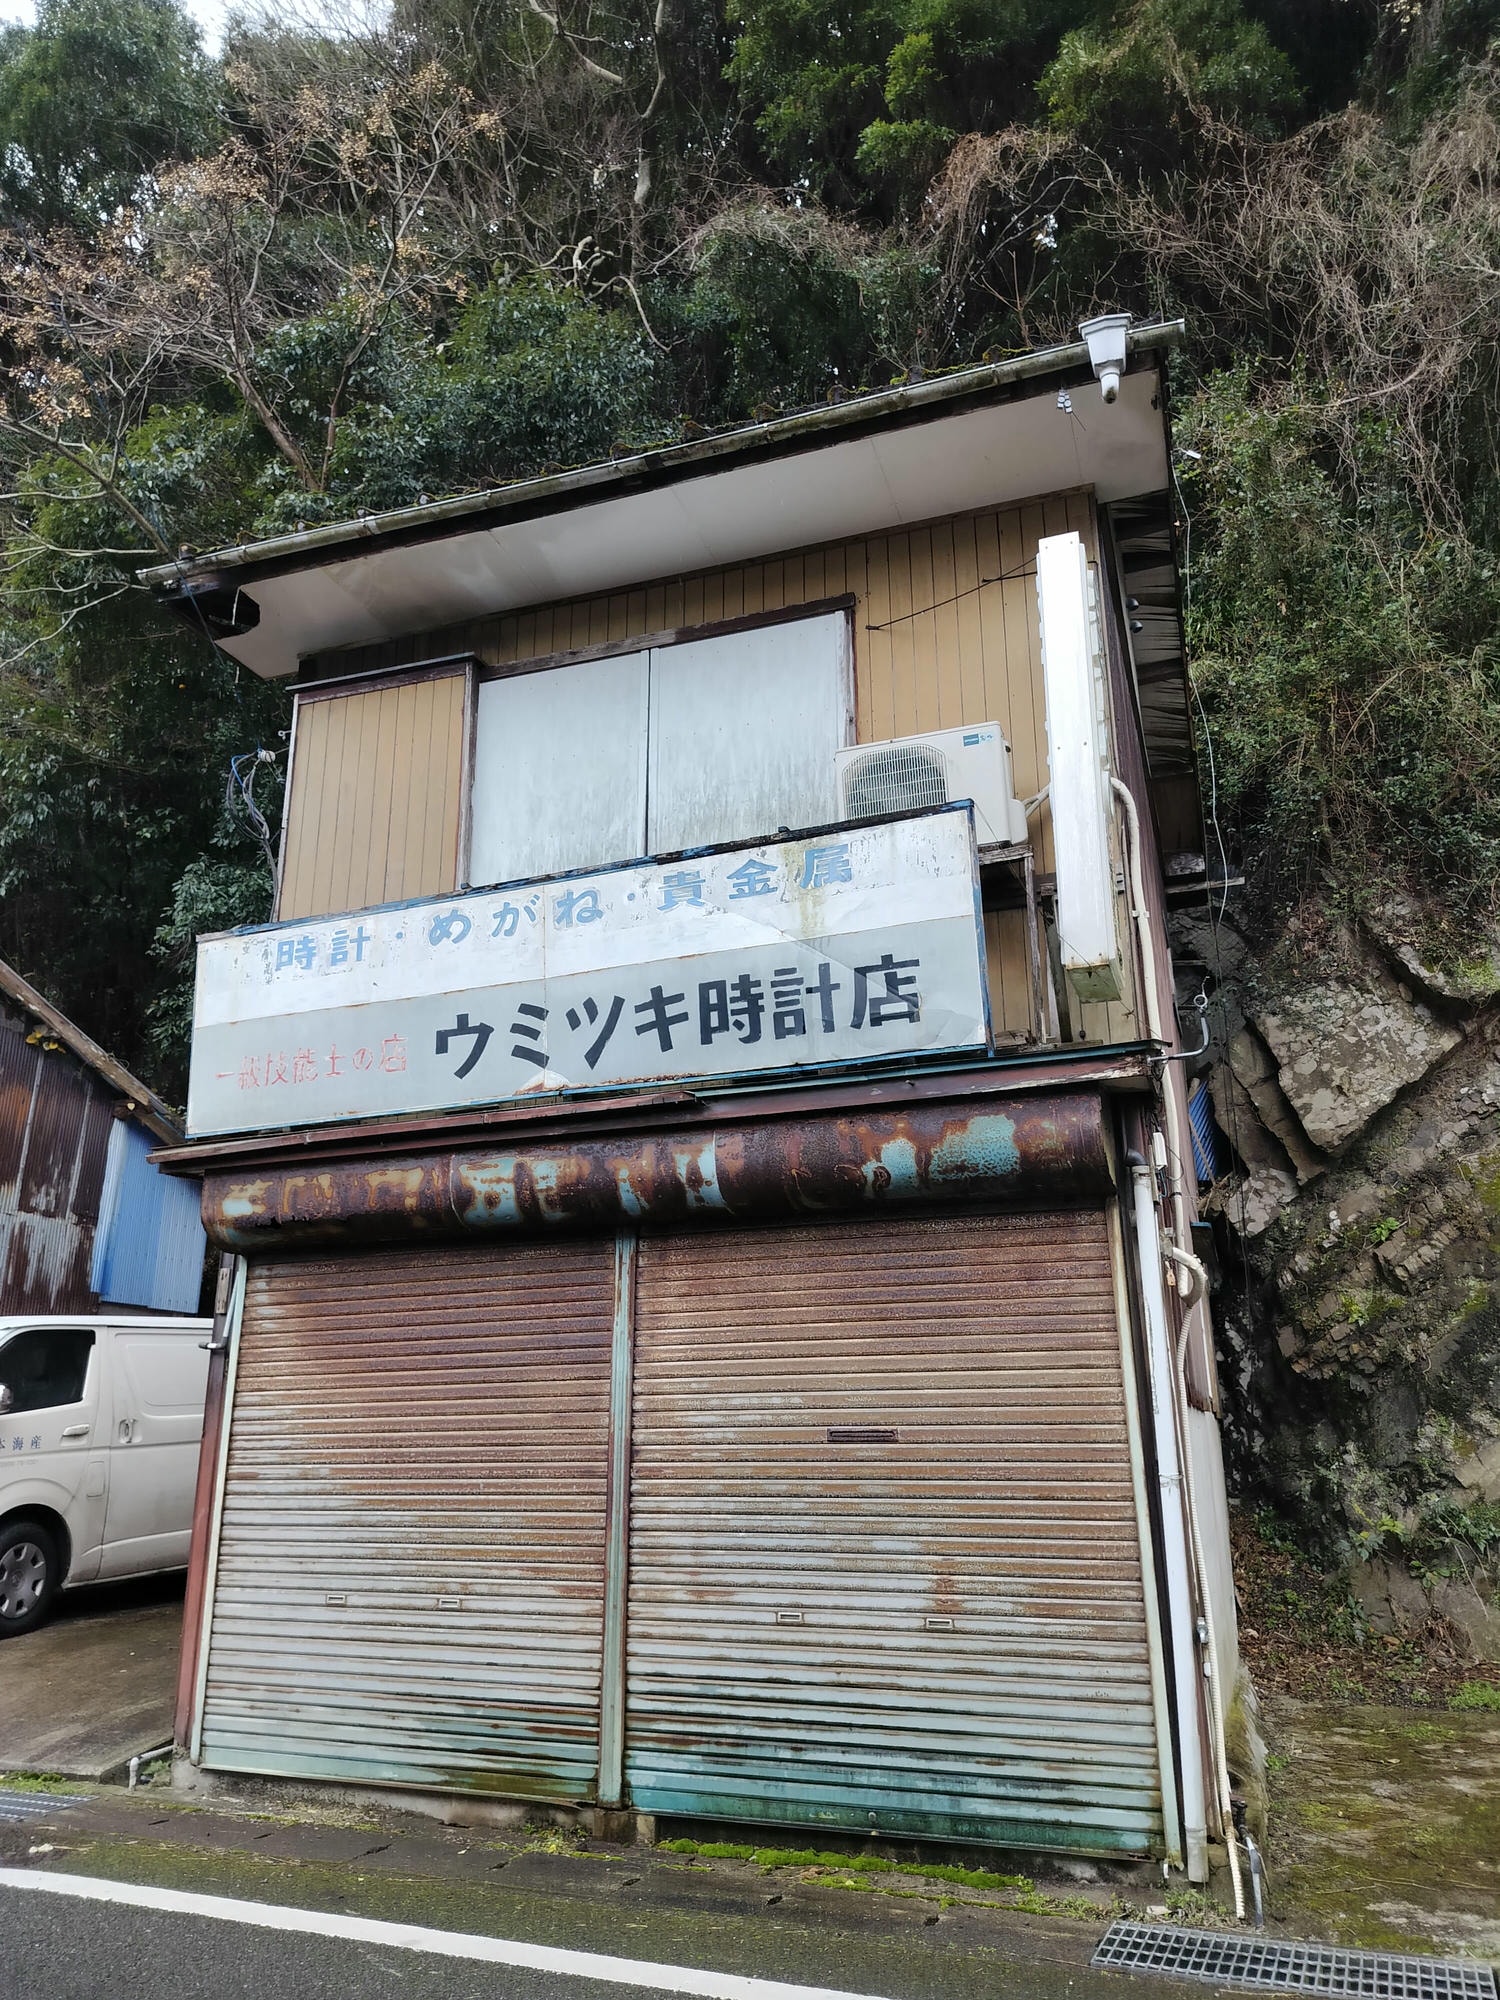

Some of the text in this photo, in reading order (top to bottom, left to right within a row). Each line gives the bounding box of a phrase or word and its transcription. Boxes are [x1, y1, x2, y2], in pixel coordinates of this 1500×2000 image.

[434, 953, 920, 1080] ウミツキ時計店
